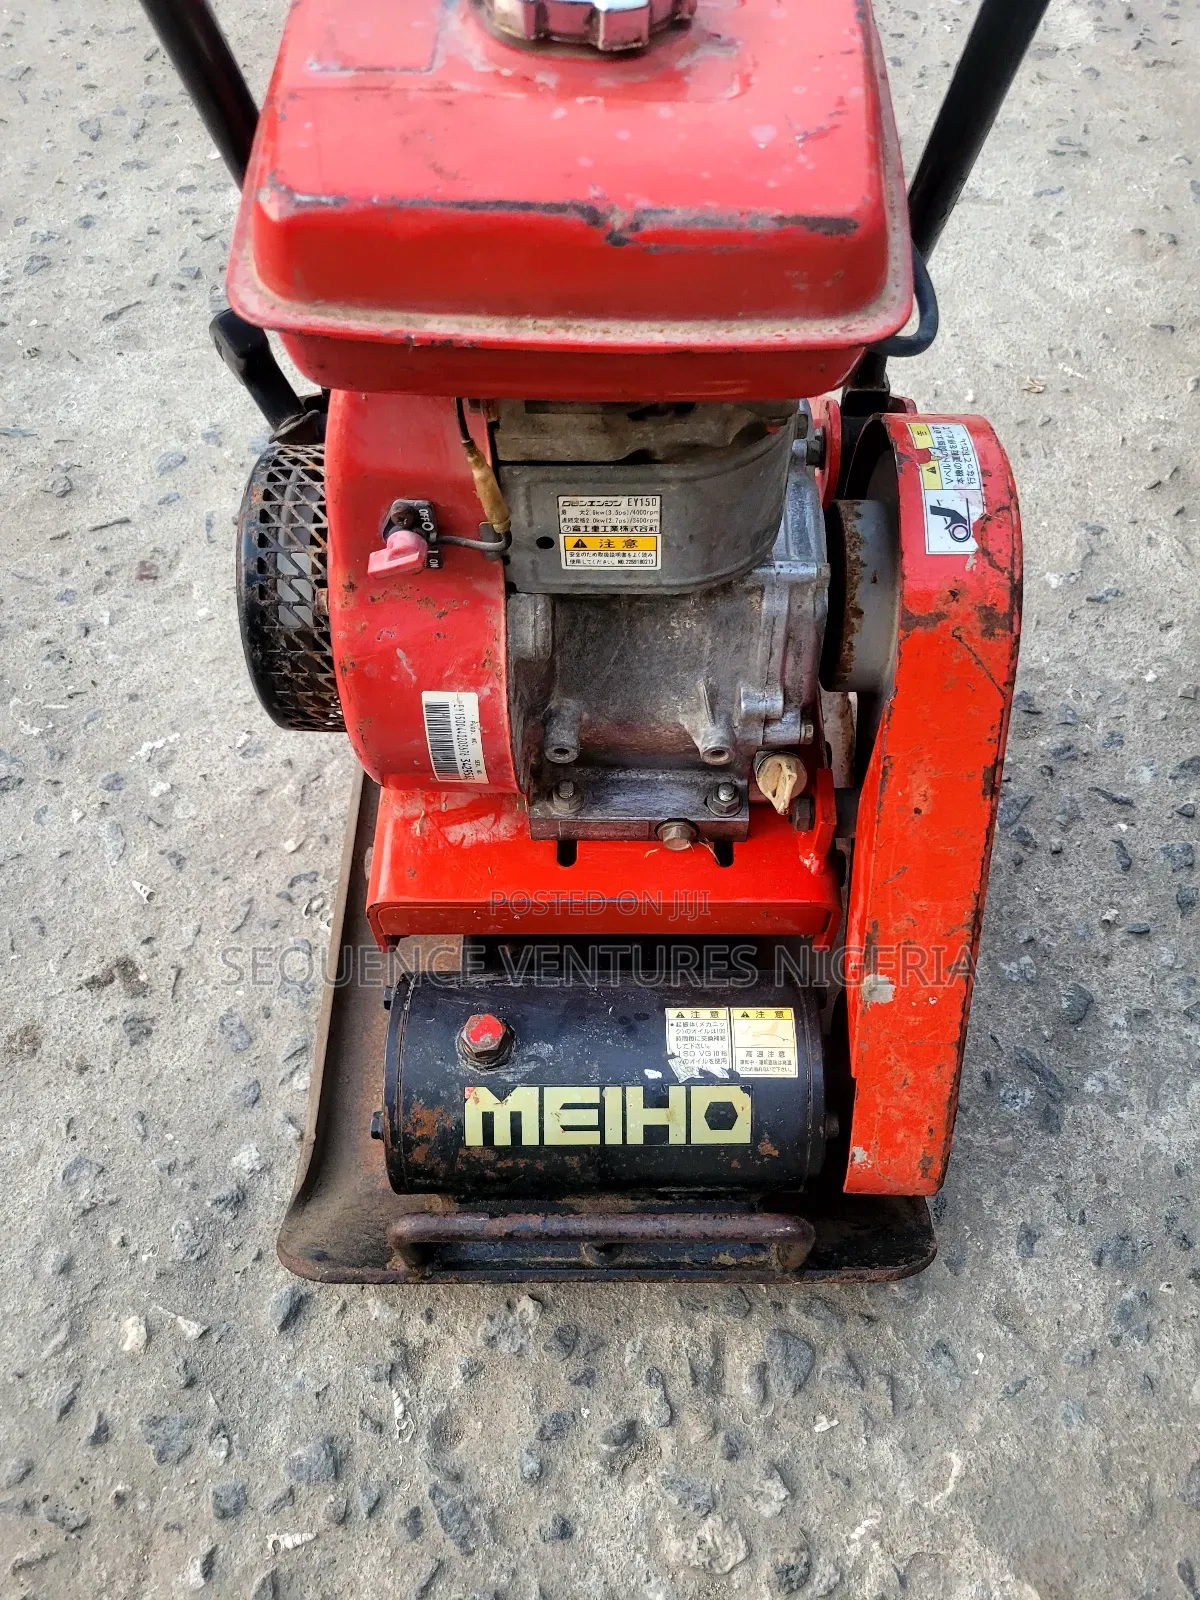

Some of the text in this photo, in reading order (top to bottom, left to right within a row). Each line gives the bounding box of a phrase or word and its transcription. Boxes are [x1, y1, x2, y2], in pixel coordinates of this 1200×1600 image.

[419, 508, 430, 522] OFF
[599, 539, 639, 549] 注意
[429, 558, 440, 568] ON
[756, 1010, 784, 1018] 注意
[465, 1086, 751, 1146] MEIHO
